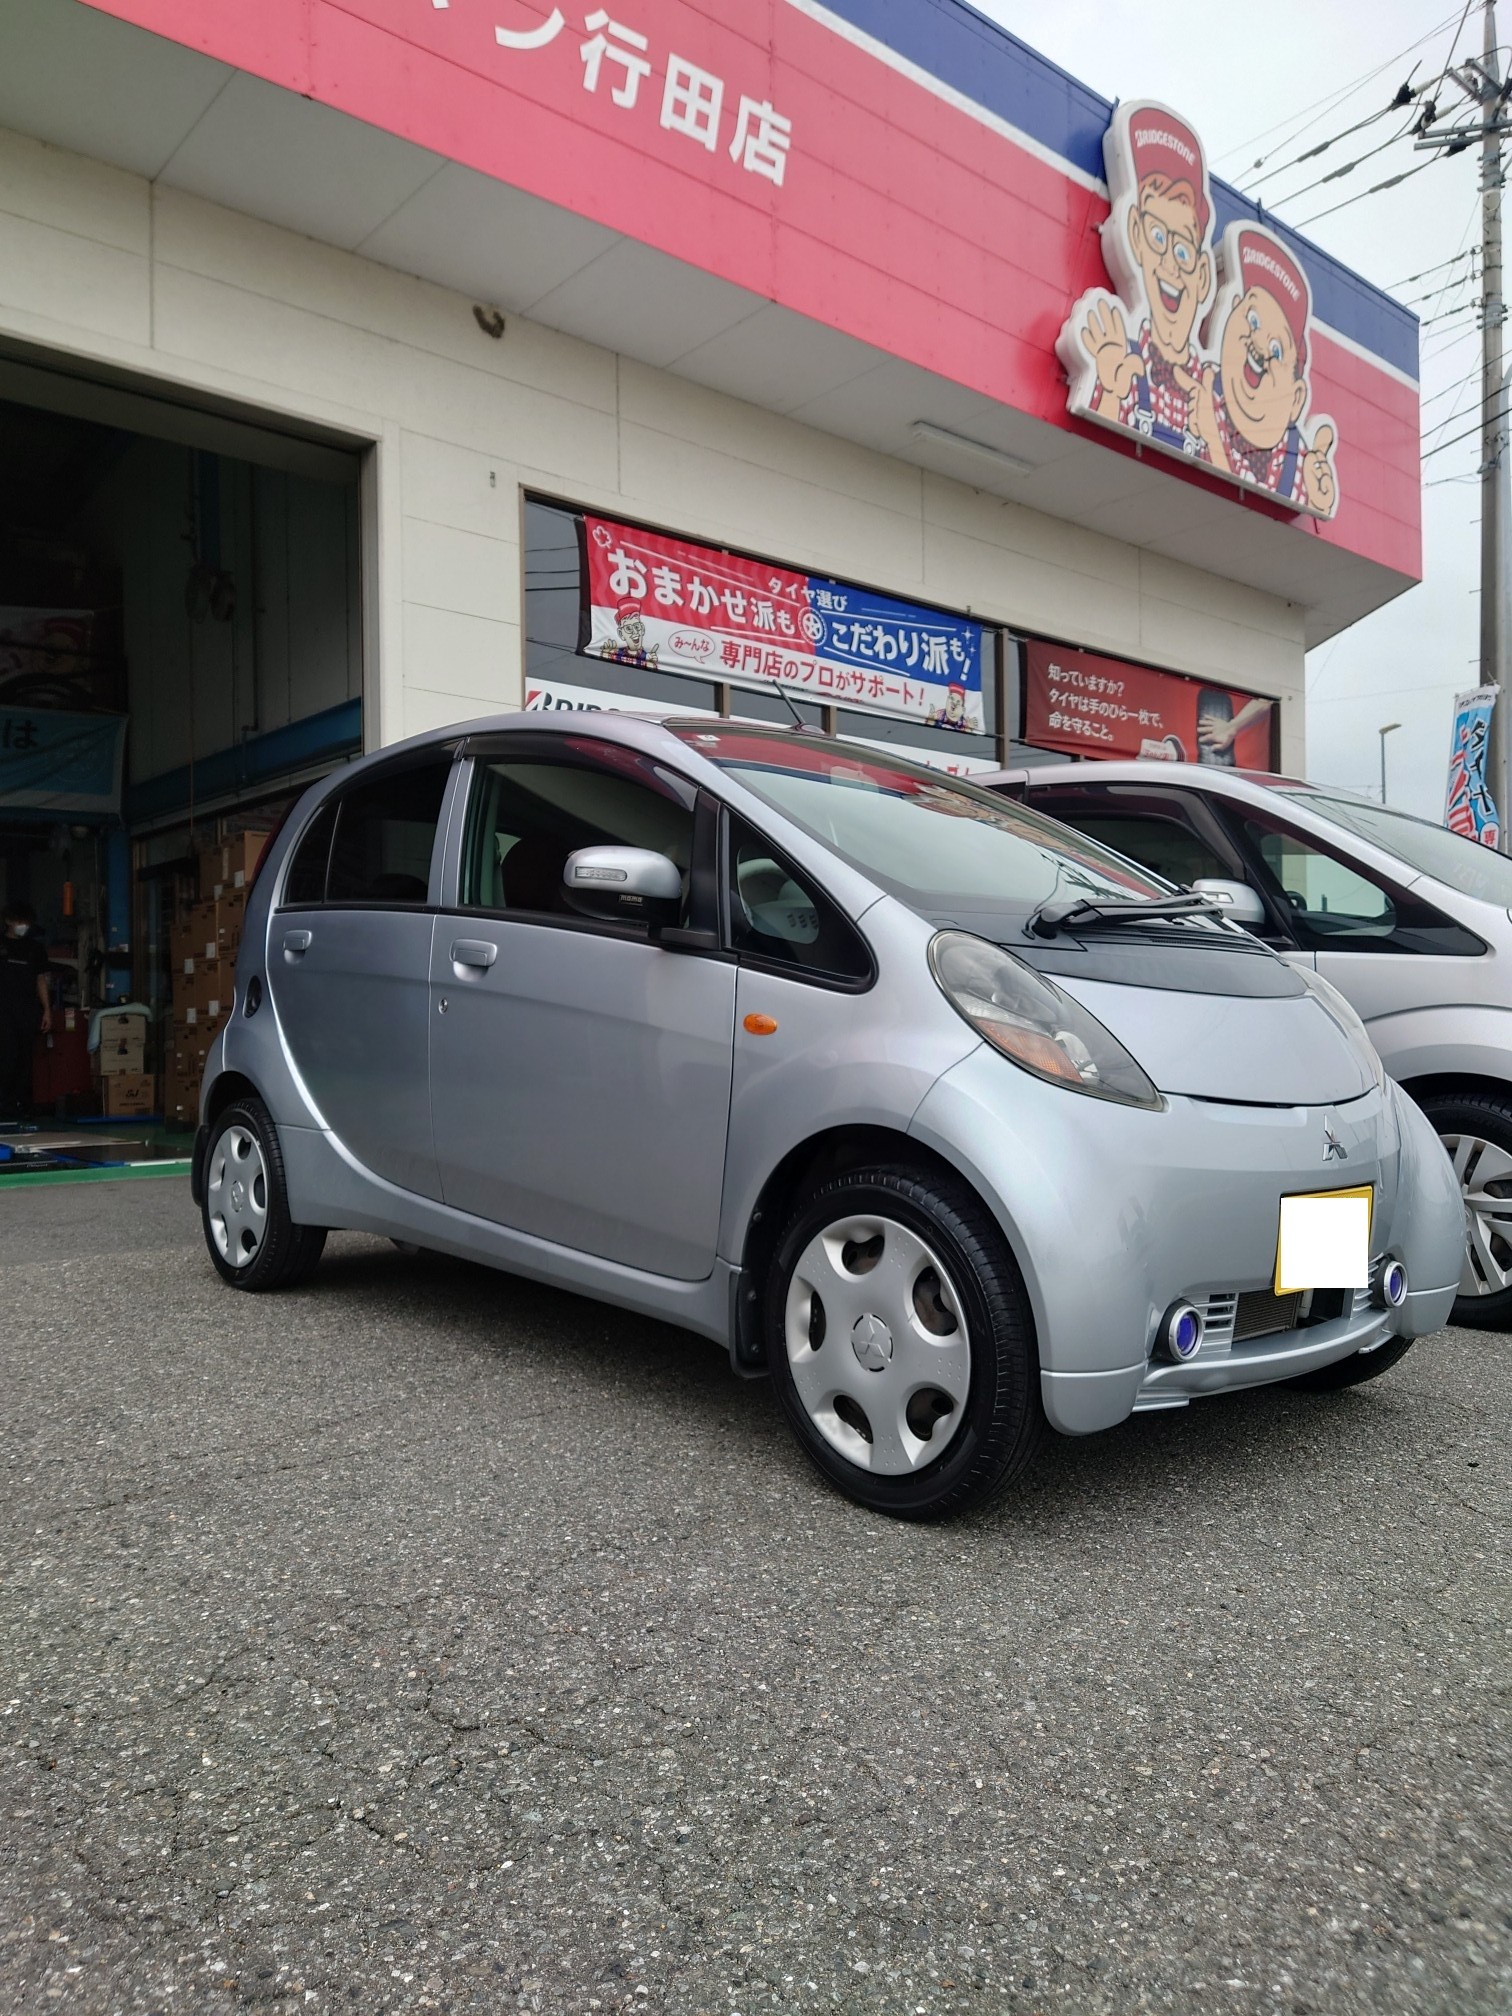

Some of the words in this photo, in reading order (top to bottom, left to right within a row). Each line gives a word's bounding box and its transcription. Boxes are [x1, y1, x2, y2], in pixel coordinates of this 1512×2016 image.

[432, 0, 792, 187] ン行田店
[1134, 128, 1197, 166] BRIDGESTONE
[1242, 246, 1300, 302] BRIDGESTONE
[606, 547, 795, 635] おまかせ派も
[768, 576, 848, 612] タイヤ選び
[719, 639, 926, 707] 専門店のプロがサポート!
[1047, 663, 1125, 697] 知っていますか?
[1048, 688, 1164, 729] タイヤは手のひら一枚で、
[1048, 711, 1114, 741] 命を守ること。
